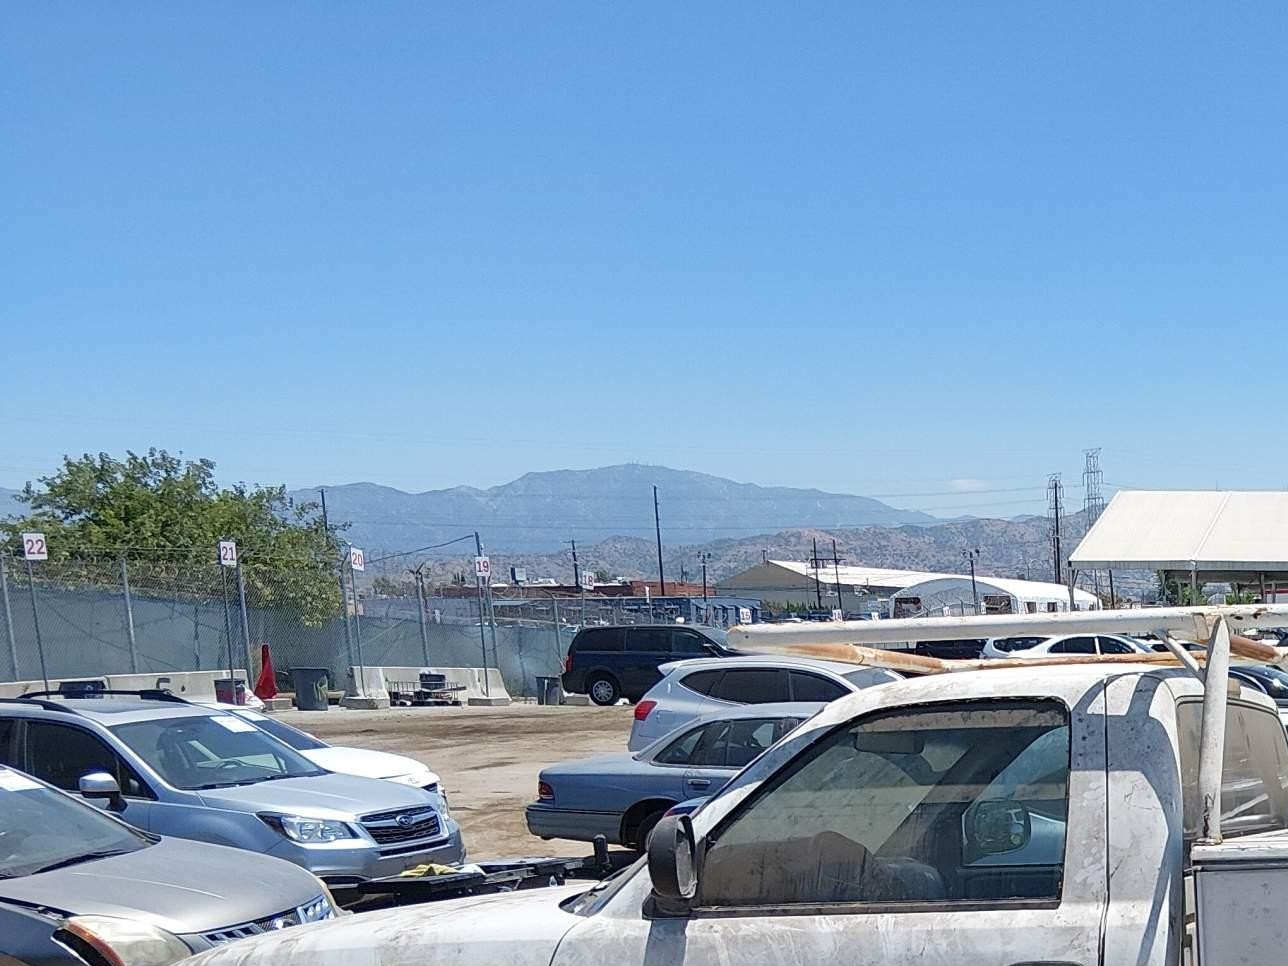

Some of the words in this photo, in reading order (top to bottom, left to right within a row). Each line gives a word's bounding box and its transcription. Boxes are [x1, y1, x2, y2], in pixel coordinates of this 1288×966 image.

[25, 538, 46, 555] 22
[221, 545, 236, 561] 21
[351, 551, 363, 567] 20
[476, 560, 490, 573] 19
[583, 574, 594, 587] 18
